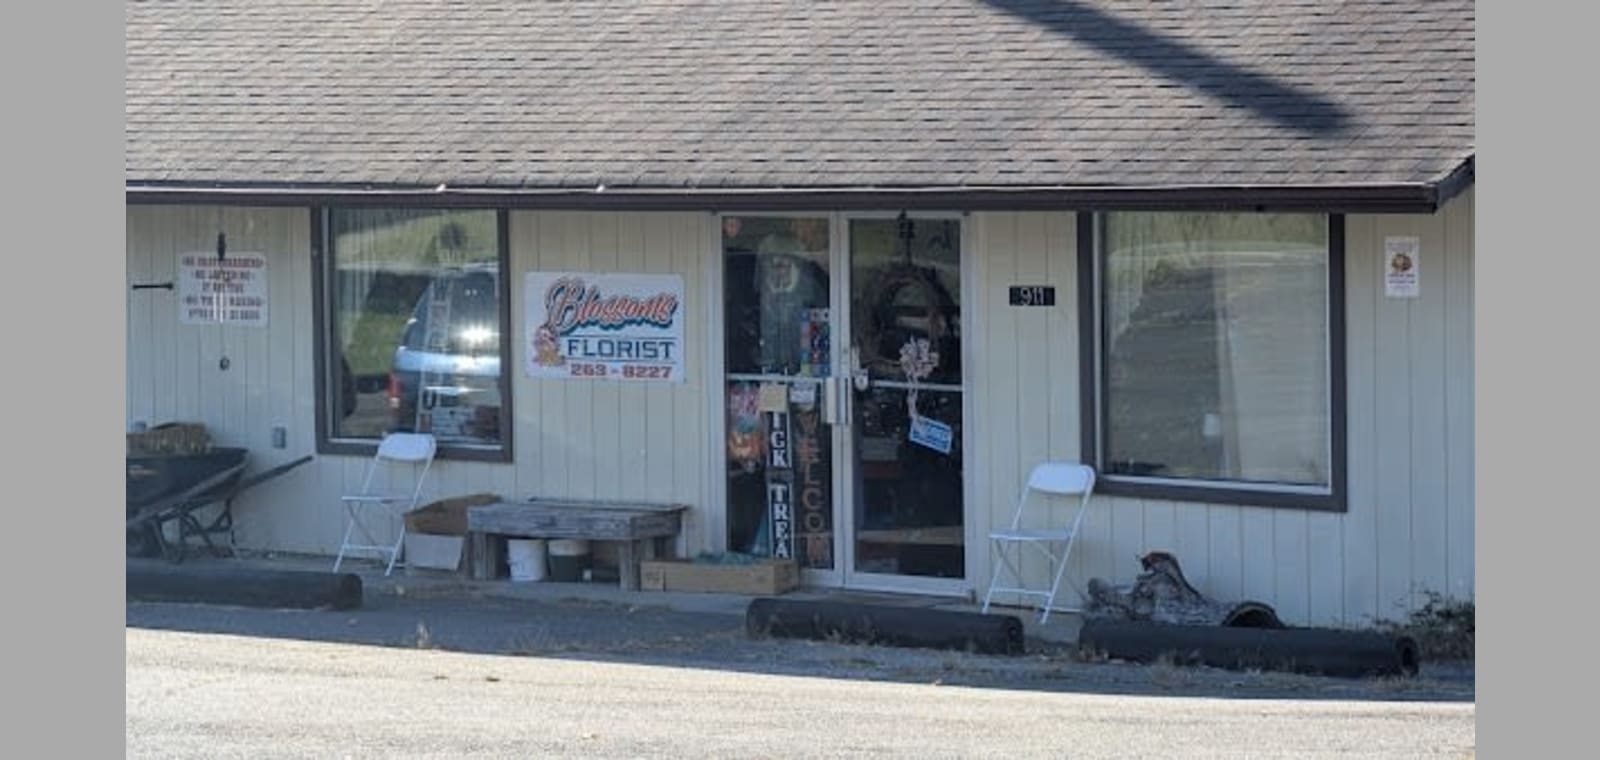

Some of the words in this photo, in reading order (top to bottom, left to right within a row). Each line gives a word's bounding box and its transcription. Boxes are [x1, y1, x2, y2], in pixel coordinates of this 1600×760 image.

[567, 338, 675, 360] FLORIST
[570, 363, 607, 376] 263
[622, 365, 673, 379] 8227
[770, 411, 788, 468] ICK
[770, 483, 790, 559] TREA
